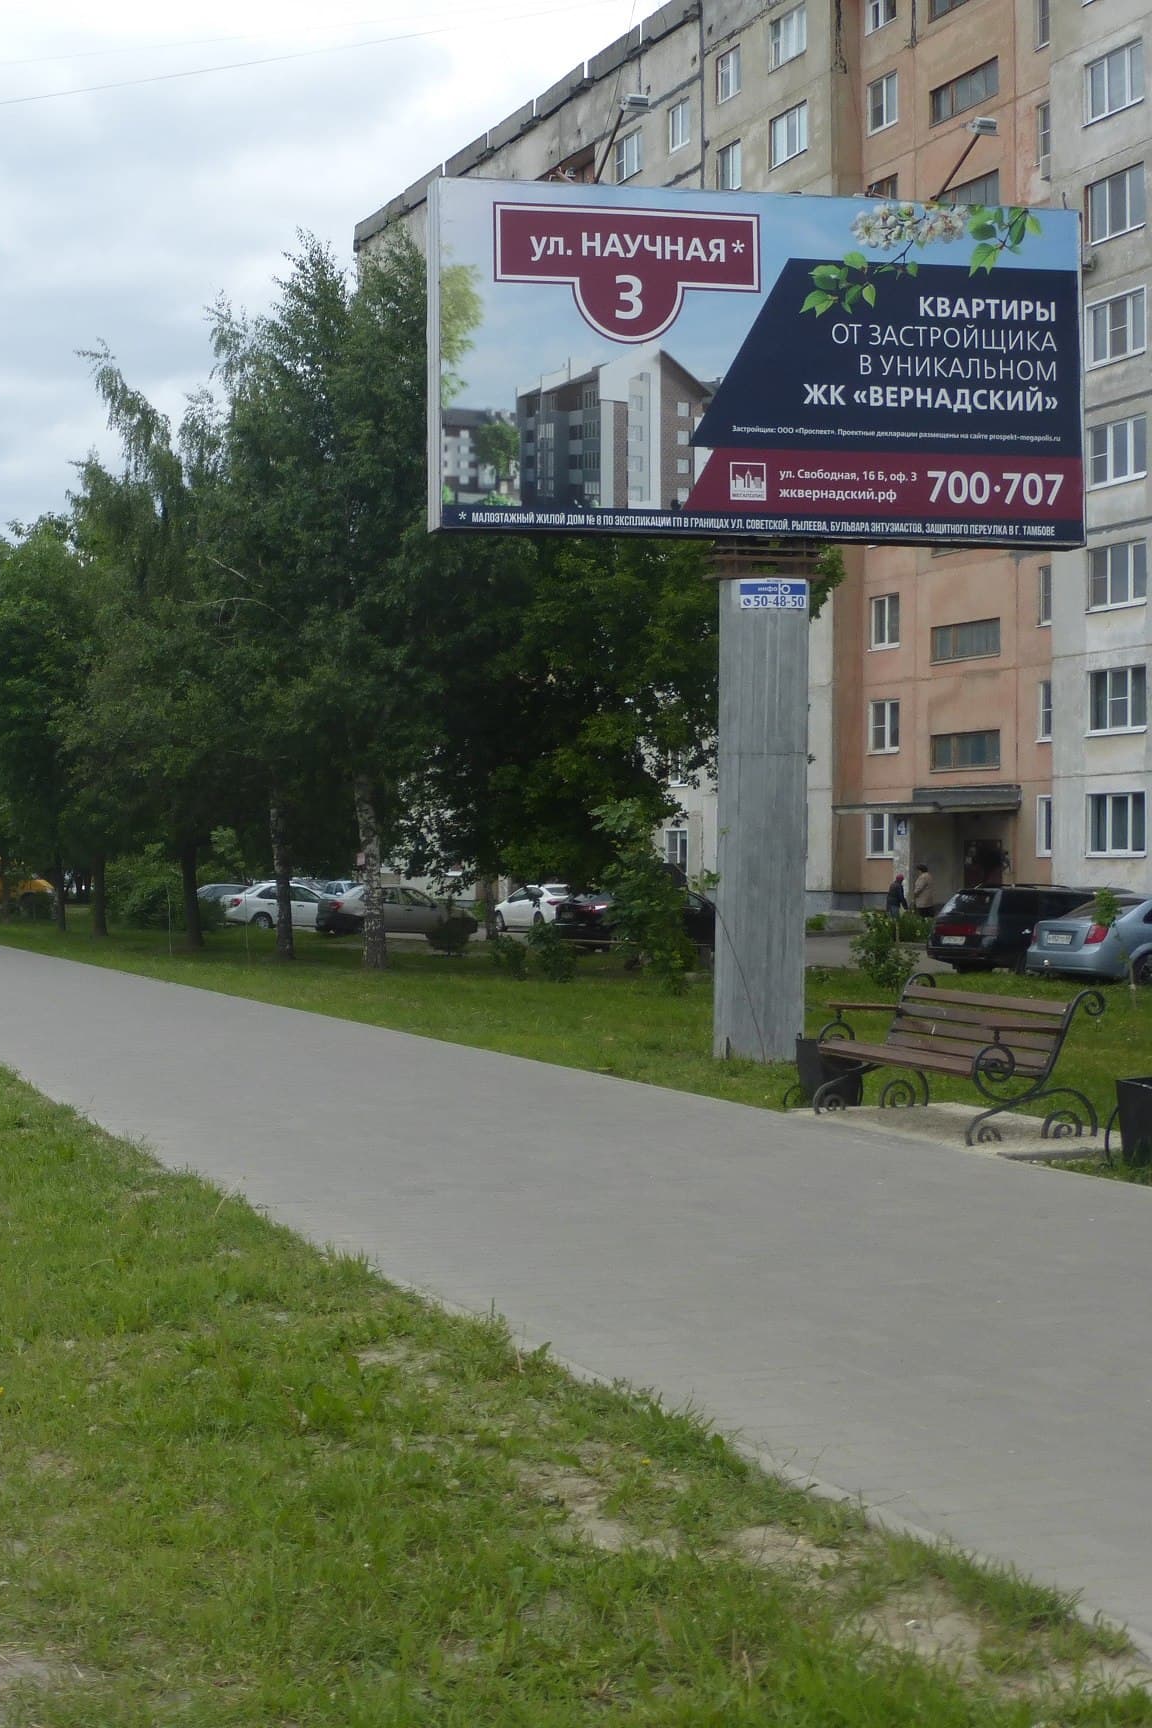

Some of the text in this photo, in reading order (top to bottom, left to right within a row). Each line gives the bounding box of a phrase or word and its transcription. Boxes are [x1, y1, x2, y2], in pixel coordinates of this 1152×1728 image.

[530, 235, 572, 262] ул.
[615, 274, 643, 320] 3
[919, 296, 1056, 322] КВАРТИРЫ
[831, 323, 1057, 354] ОТ ЗАСТРОЙЩИКА
[859, 354, 1057, 381] В УНИКАЛЬНОМ
[802, 384, 1058, 413] ЖК «ВЕРНАДСКИЙ»
[732, 425, 776, 434] Застройщик:
[777, 426, 794, 434] ООО
[837, 428, 875, 438] Проектные
[876, 430, 918, 439] декларации
[919, 431, 959, 440] размещены
[970, 432, 988, 440] сайте
[989, 433, 1061, 443] prospekt-megapolis.ru
[779, 468, 917, 485] ул. Свободная, 16 Б, оф. 3
[779, 487, 897, 503] жквернадский.рф
[472, 512, 534, 523] МАЛОЭТАЖНЫЙ
[536, 512, 565, 524] ЖИЛОЙ
[566, 514, 584, 525] ДОМ
[596, 515, 601, 525] 8
[603, 515, 613, 526] ПО
[614, 515, 672, 527] ЭКСПЛИКАЦИИ
[672, 517, 682, 527] ГП
[683, 517, 689, 527] В
[690, 517, 729, 529] ГРАНИЦАХ
[731, 519, 744, 529] УЛ.
[791, 520, 829, 532] РЫЛЕЕВА,
[830, 521, 869, 532] БУЛЬВАРА
[870, 522, 924, 534] ЭНТУЗИАСТОВ,
[925, 523, 968, 535] ЗАЩИТНОГО
[969, 524, 1008, 536] ПЕРЕУЛКА
[1008, 525, 1014, 536] В
[1015, 525, 1021, 536] Г.
[1023, 525, 1056, 537] ТАМБОВЕ
[753, 595, 805, 607] 50-48-50
